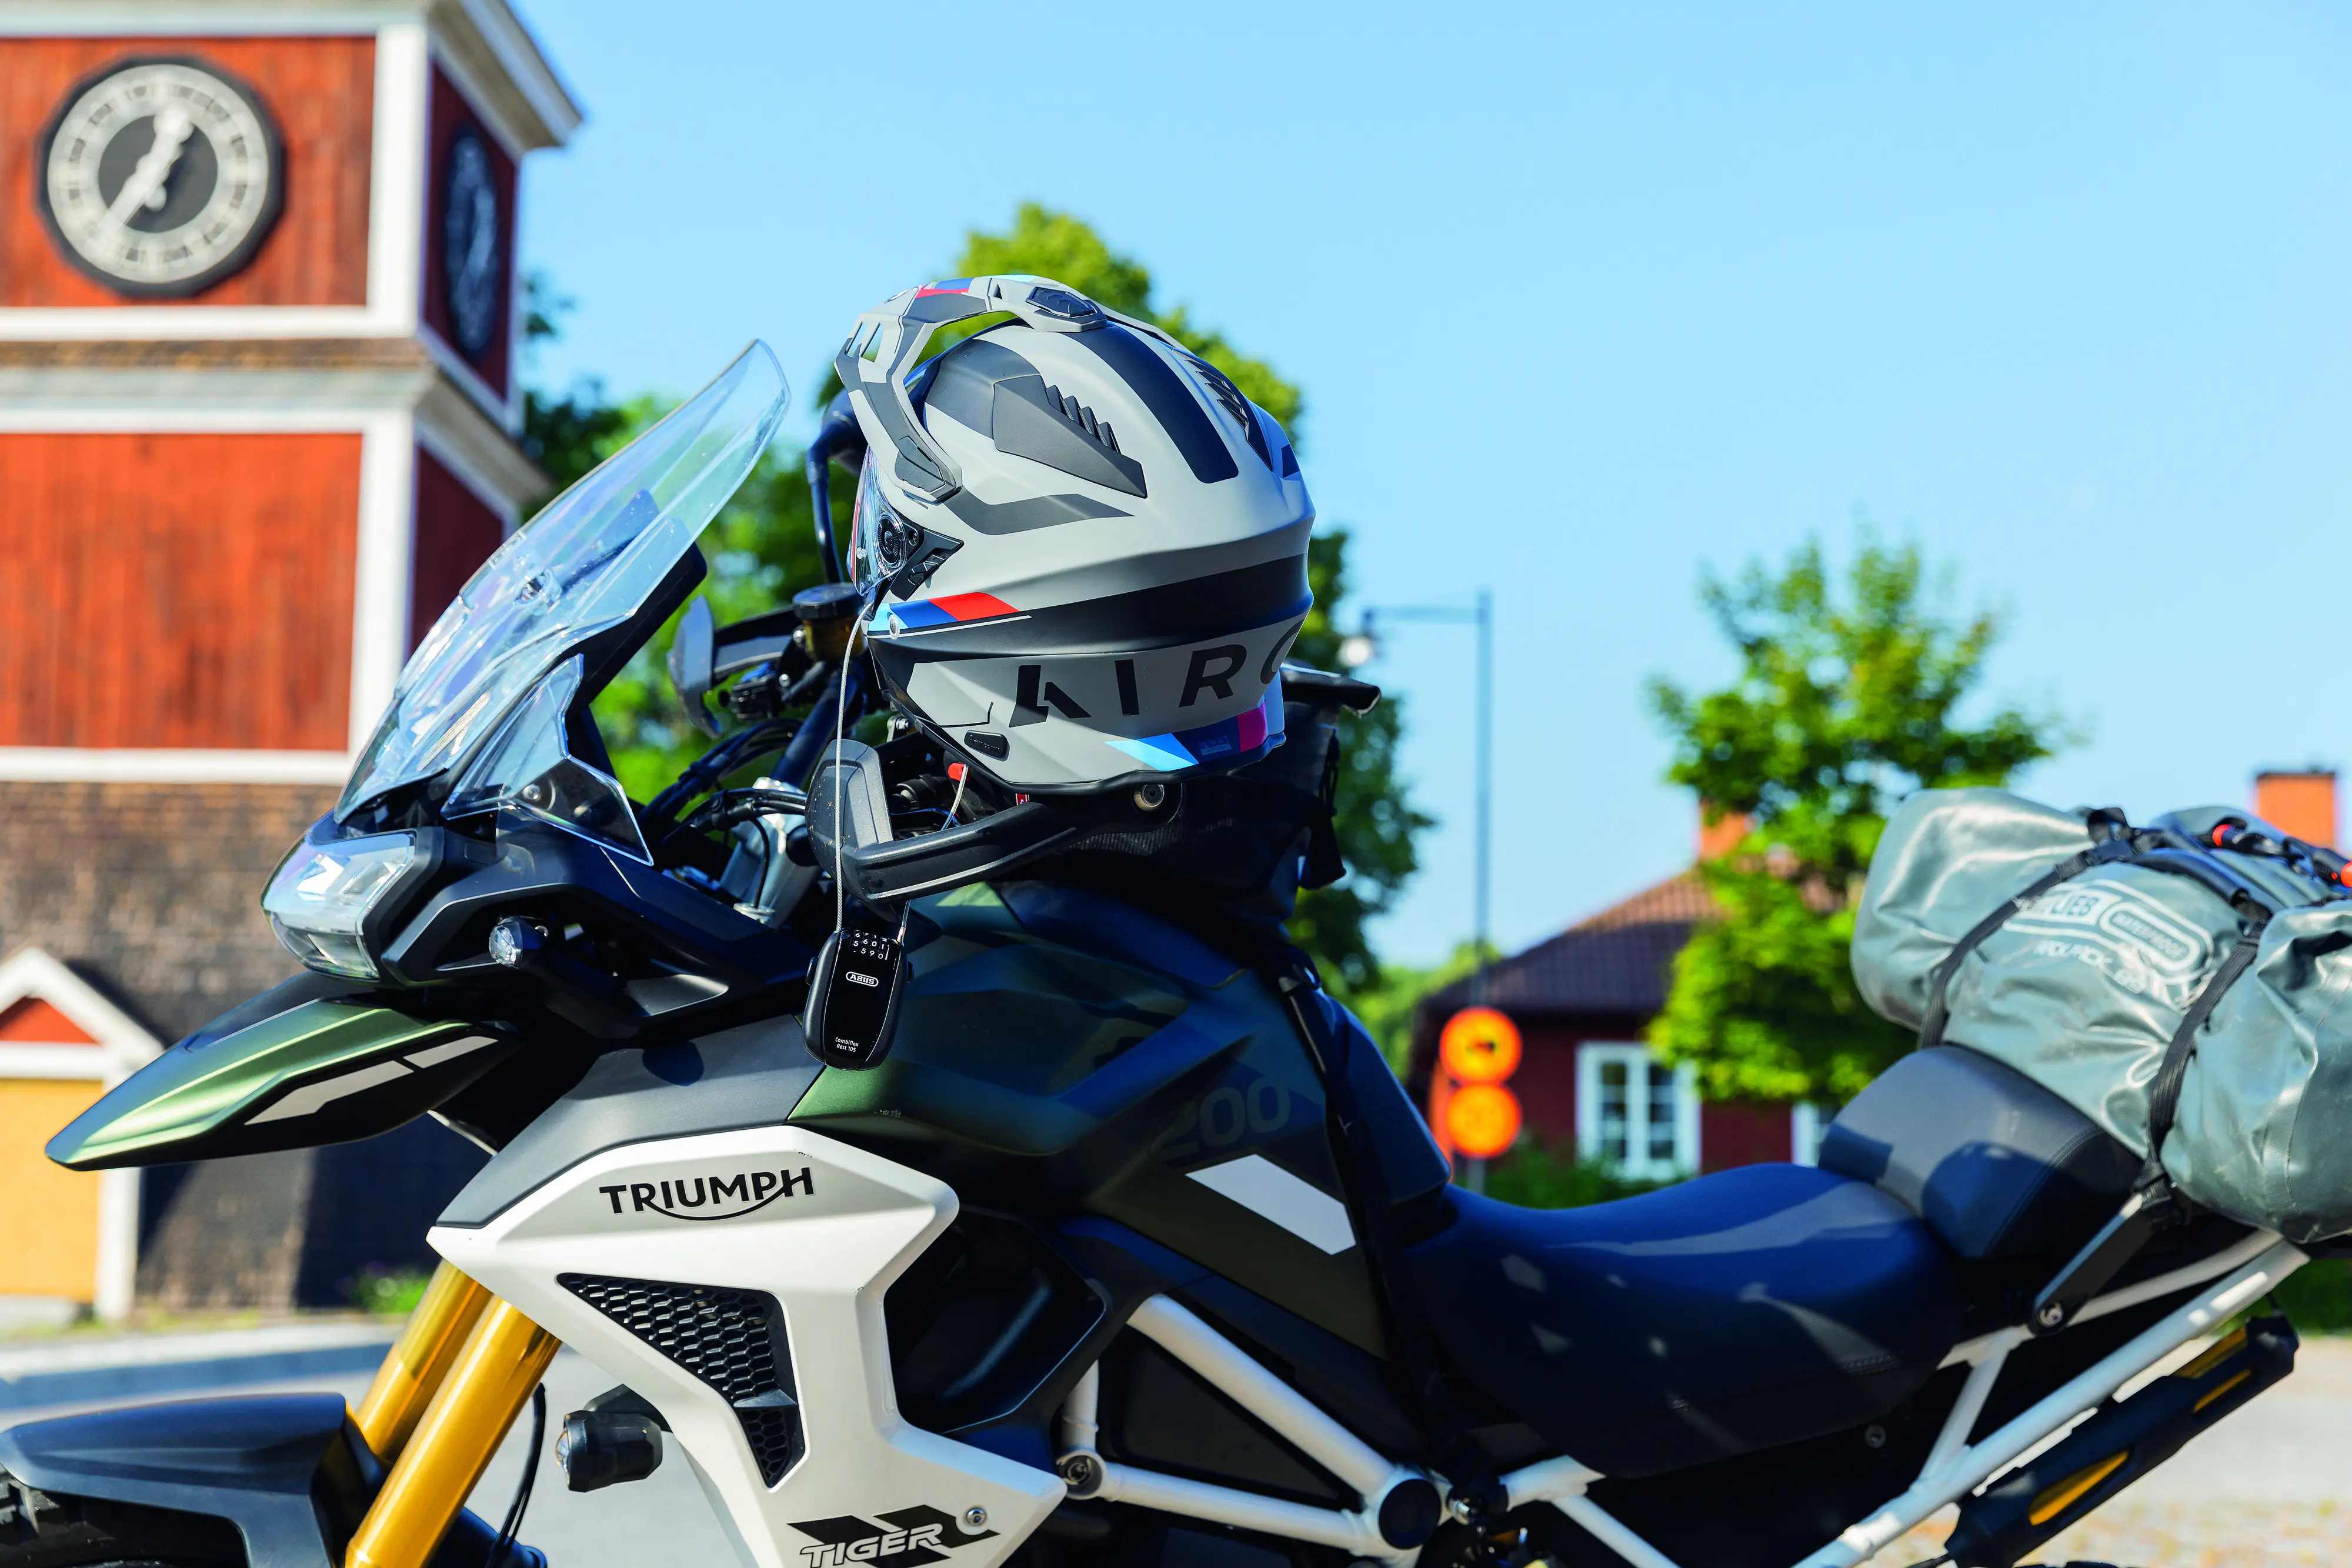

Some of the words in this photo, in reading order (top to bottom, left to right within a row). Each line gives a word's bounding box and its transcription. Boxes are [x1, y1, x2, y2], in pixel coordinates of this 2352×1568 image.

[849, 973, 875, 985] ABUS
[835, 1037, 859, 1047] Combiflex
[599, 1166, 815, 1222] TRIUMPH
[799, 1522, 943, 1568] TIGER
